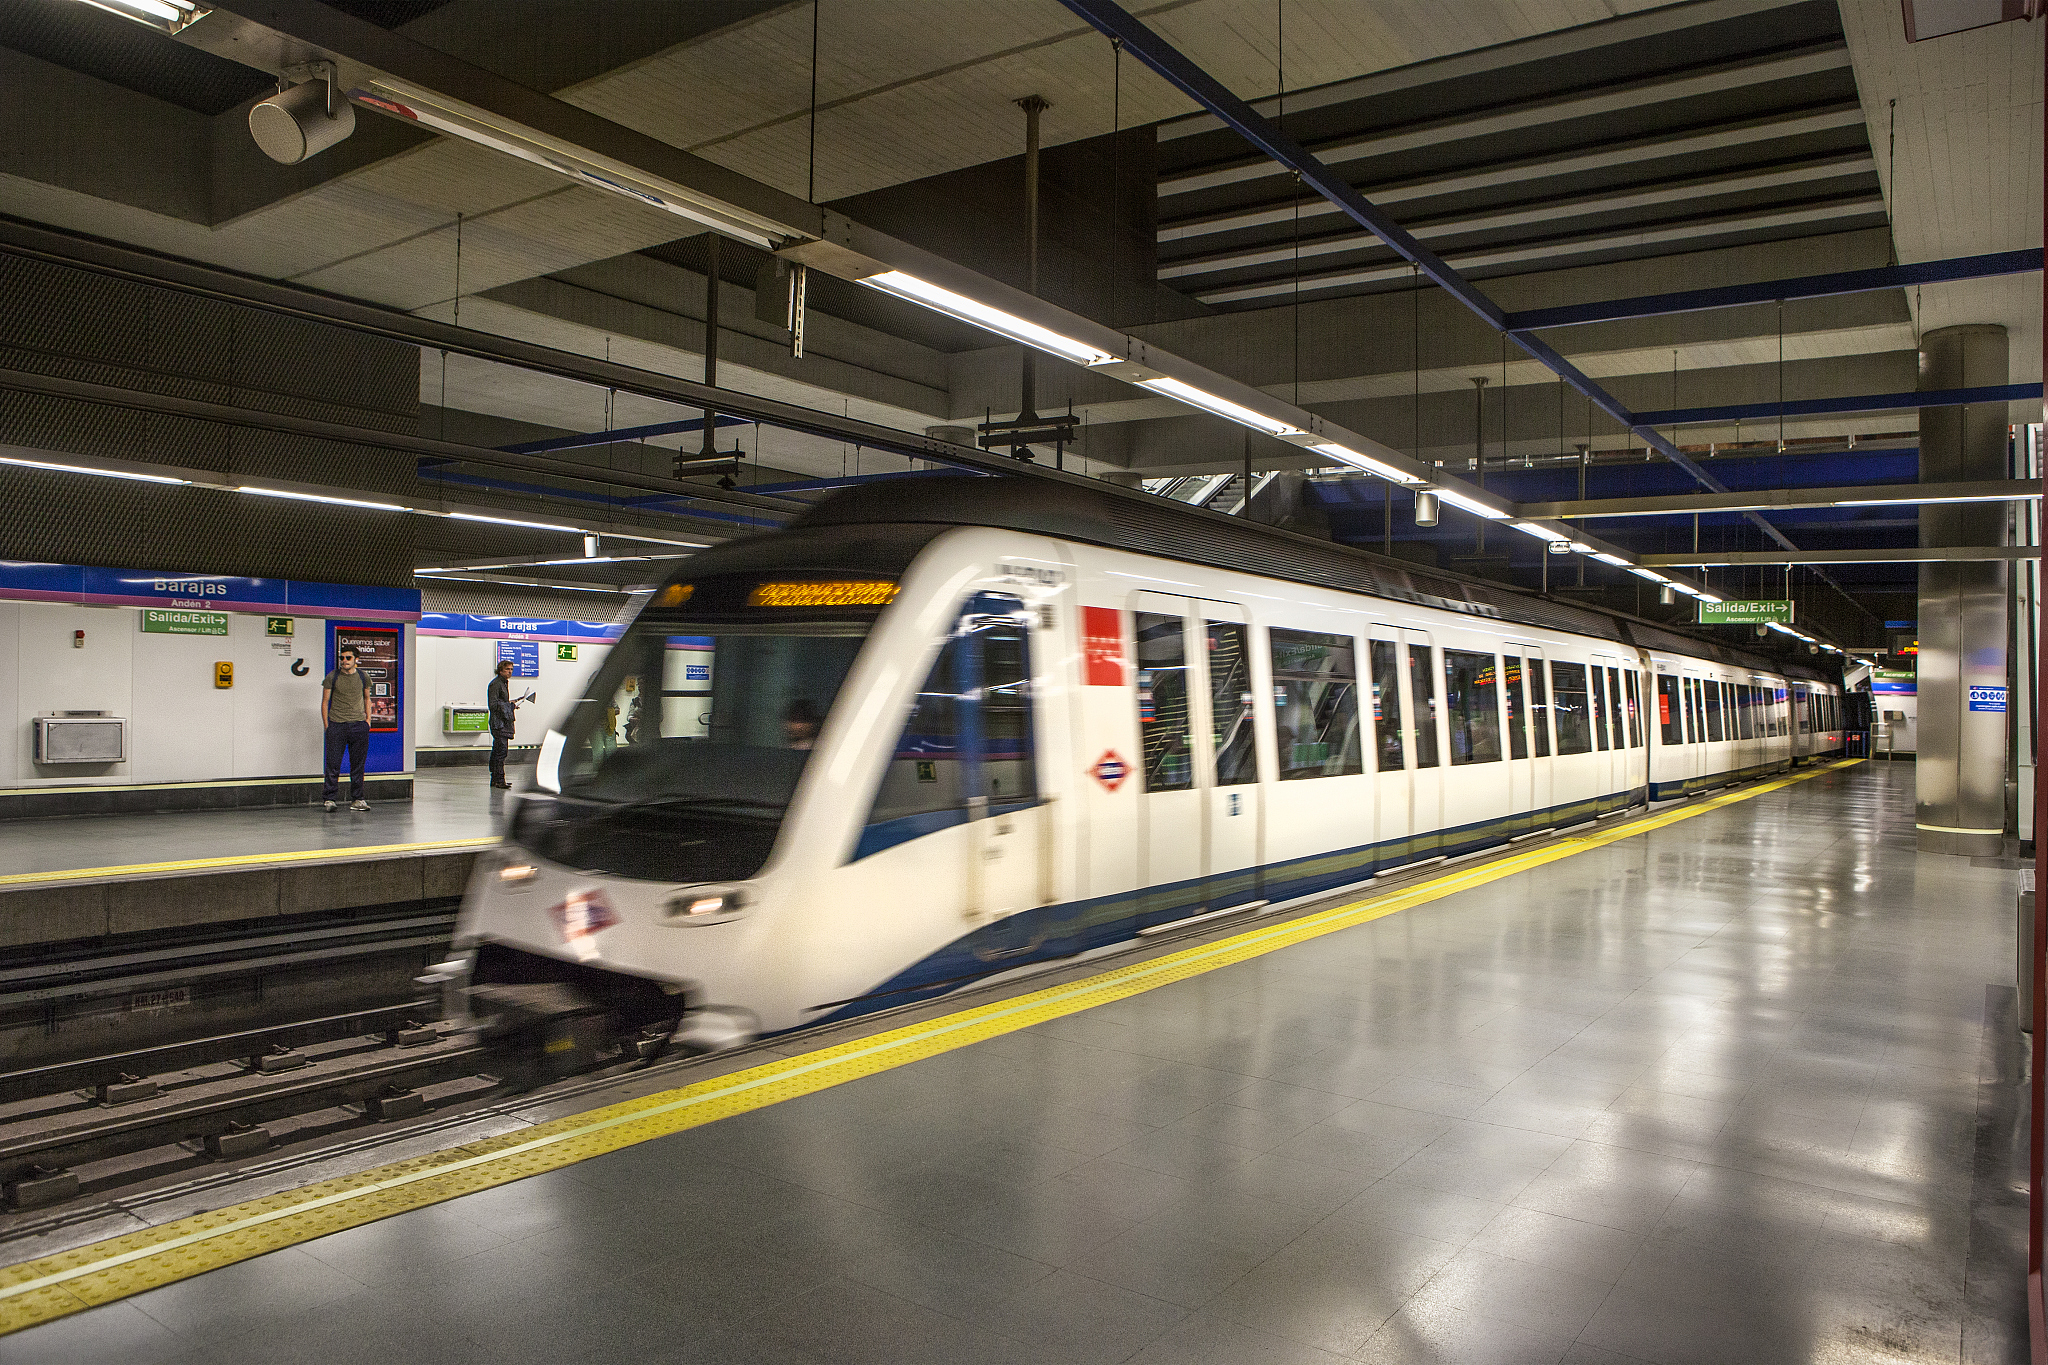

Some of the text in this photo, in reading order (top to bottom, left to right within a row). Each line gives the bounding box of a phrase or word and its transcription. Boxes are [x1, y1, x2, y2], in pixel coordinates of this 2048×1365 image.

[154, 577, 227, 597] Barajas
[171, 599, 211, 609] Andén 2
[1705, 602, 1775, 613] Salida/Exit
[149, 611, 215, 624] Salida/Exit
[500, 619, 538, 632] Barajas
[341, 637, 391, 647] Queremos saber
